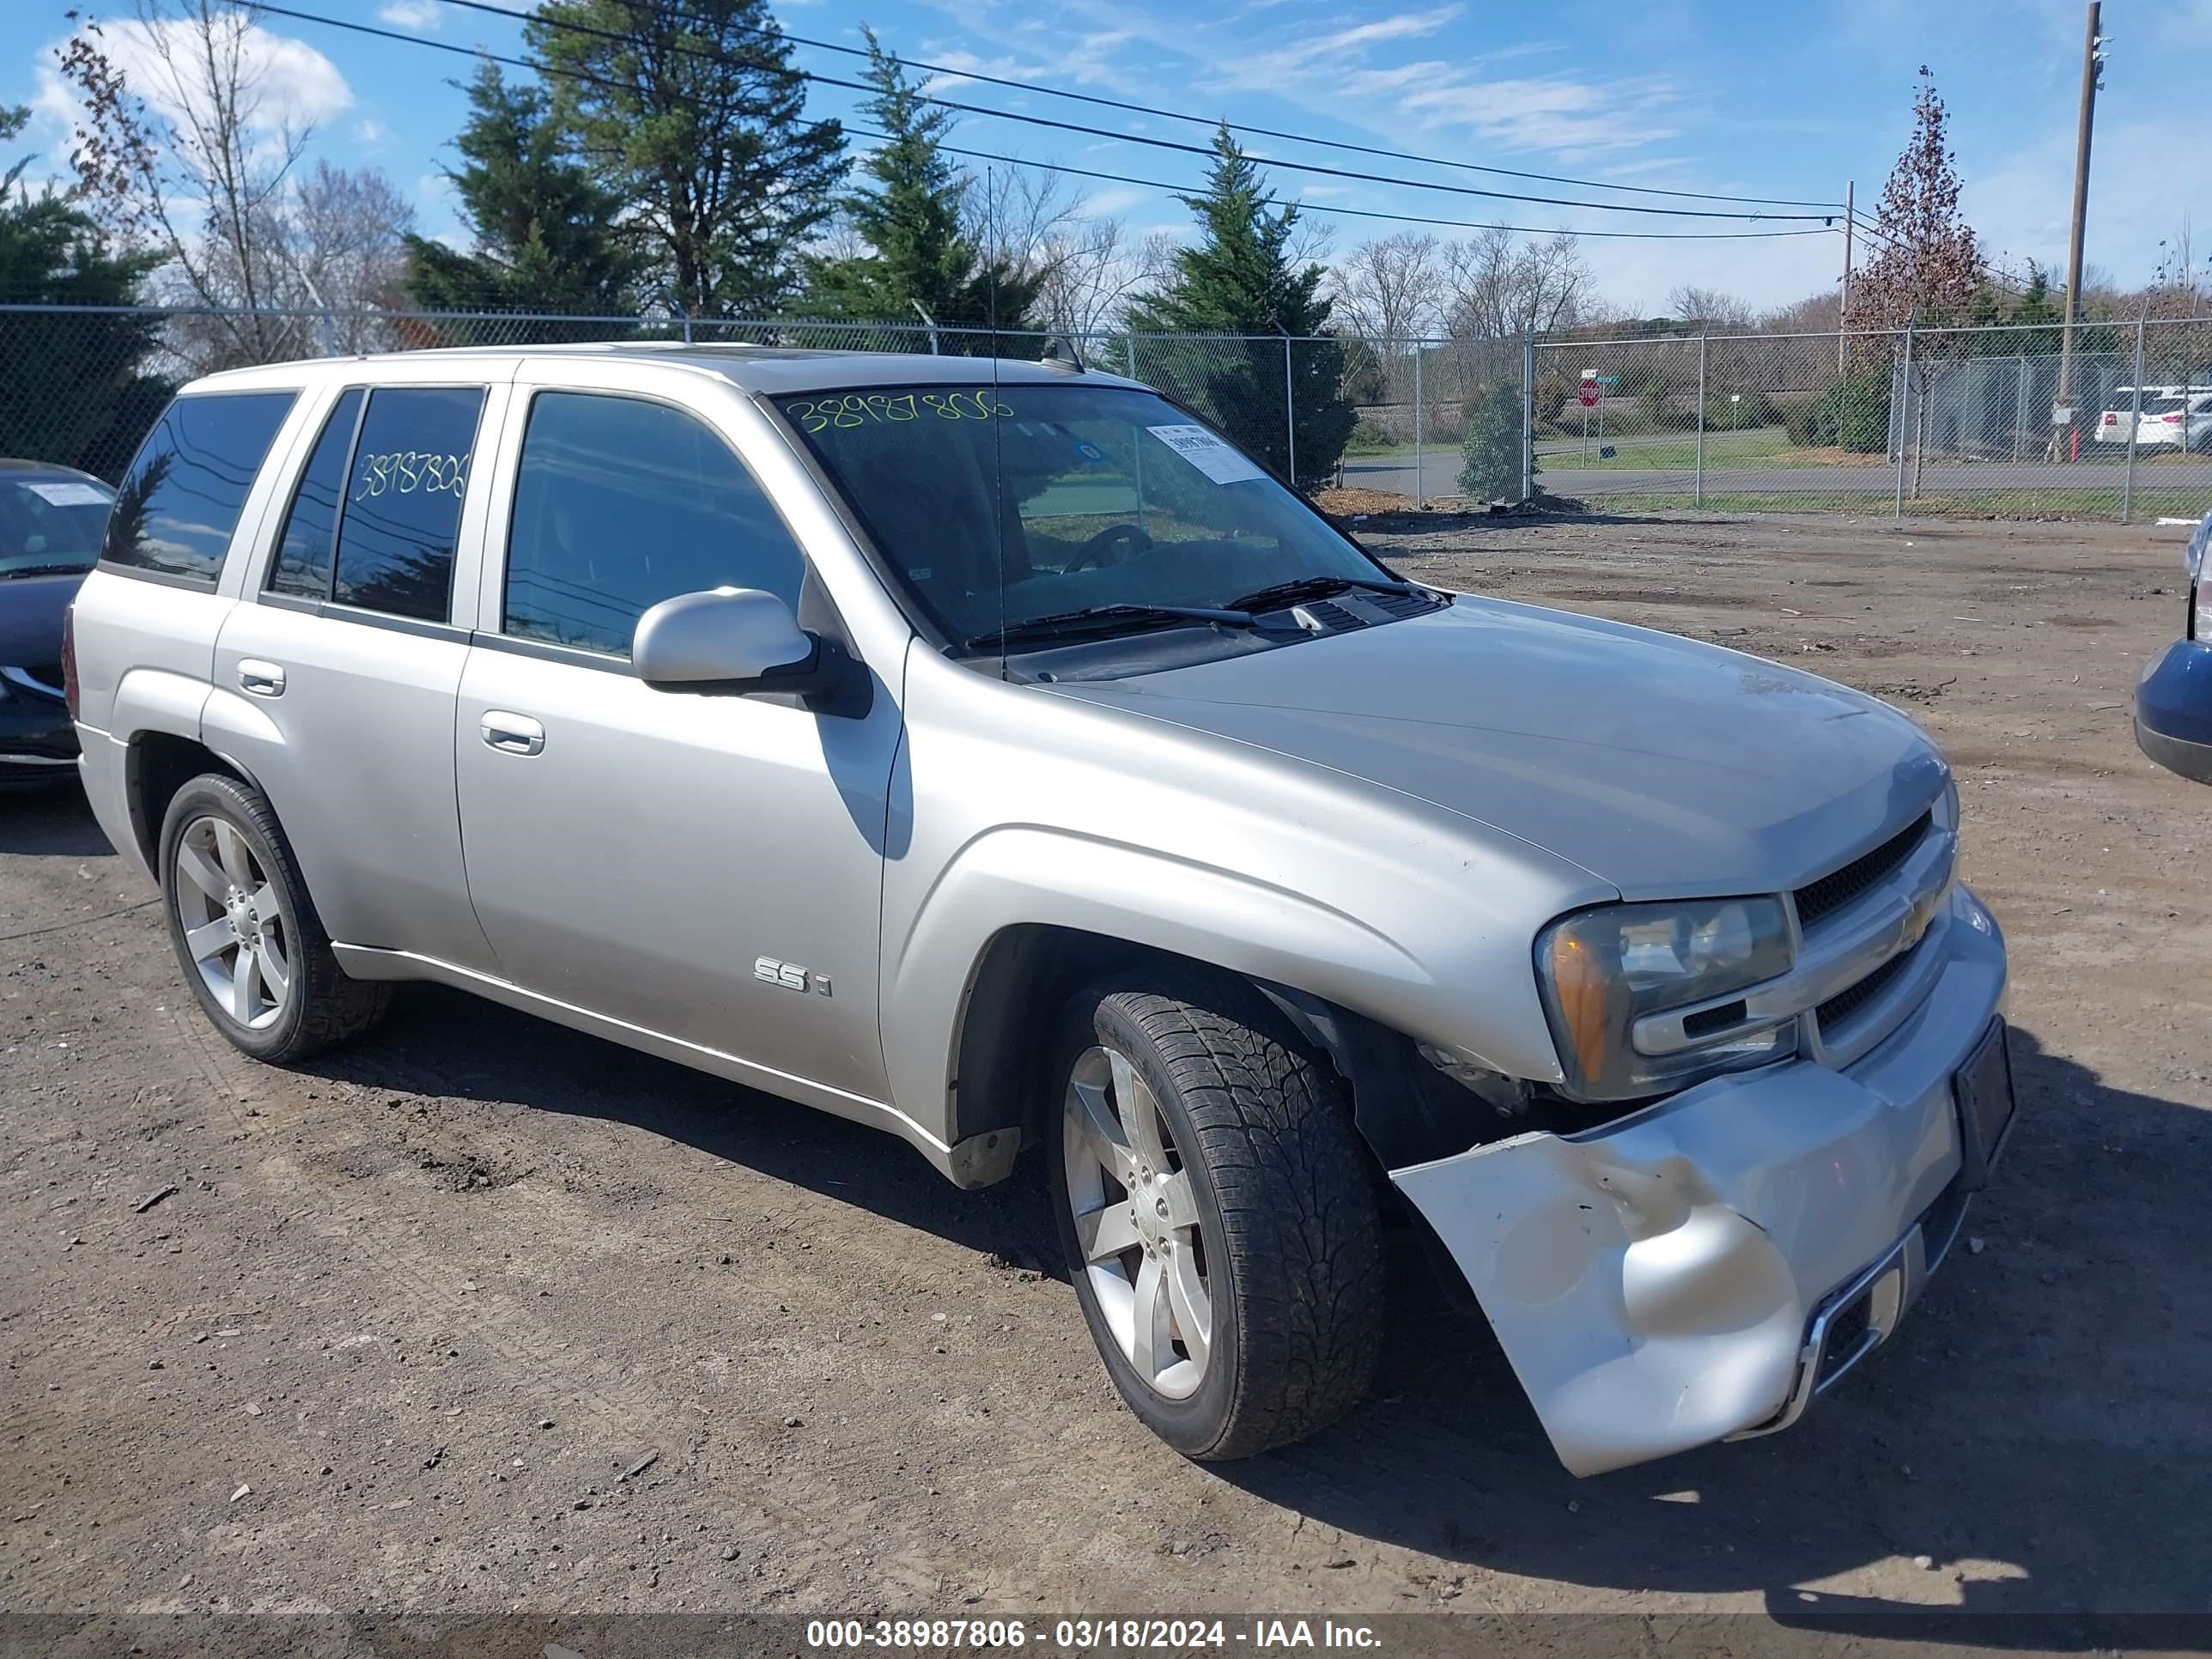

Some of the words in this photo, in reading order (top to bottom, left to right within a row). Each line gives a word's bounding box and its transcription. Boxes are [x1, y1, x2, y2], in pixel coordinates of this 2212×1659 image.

[786, 391, 1014, 434] 38987806
[1580, 387, 1599, 399] STOP
[356, 451, 470, 501] 38987806
[753, 956, 809, 993] SS
